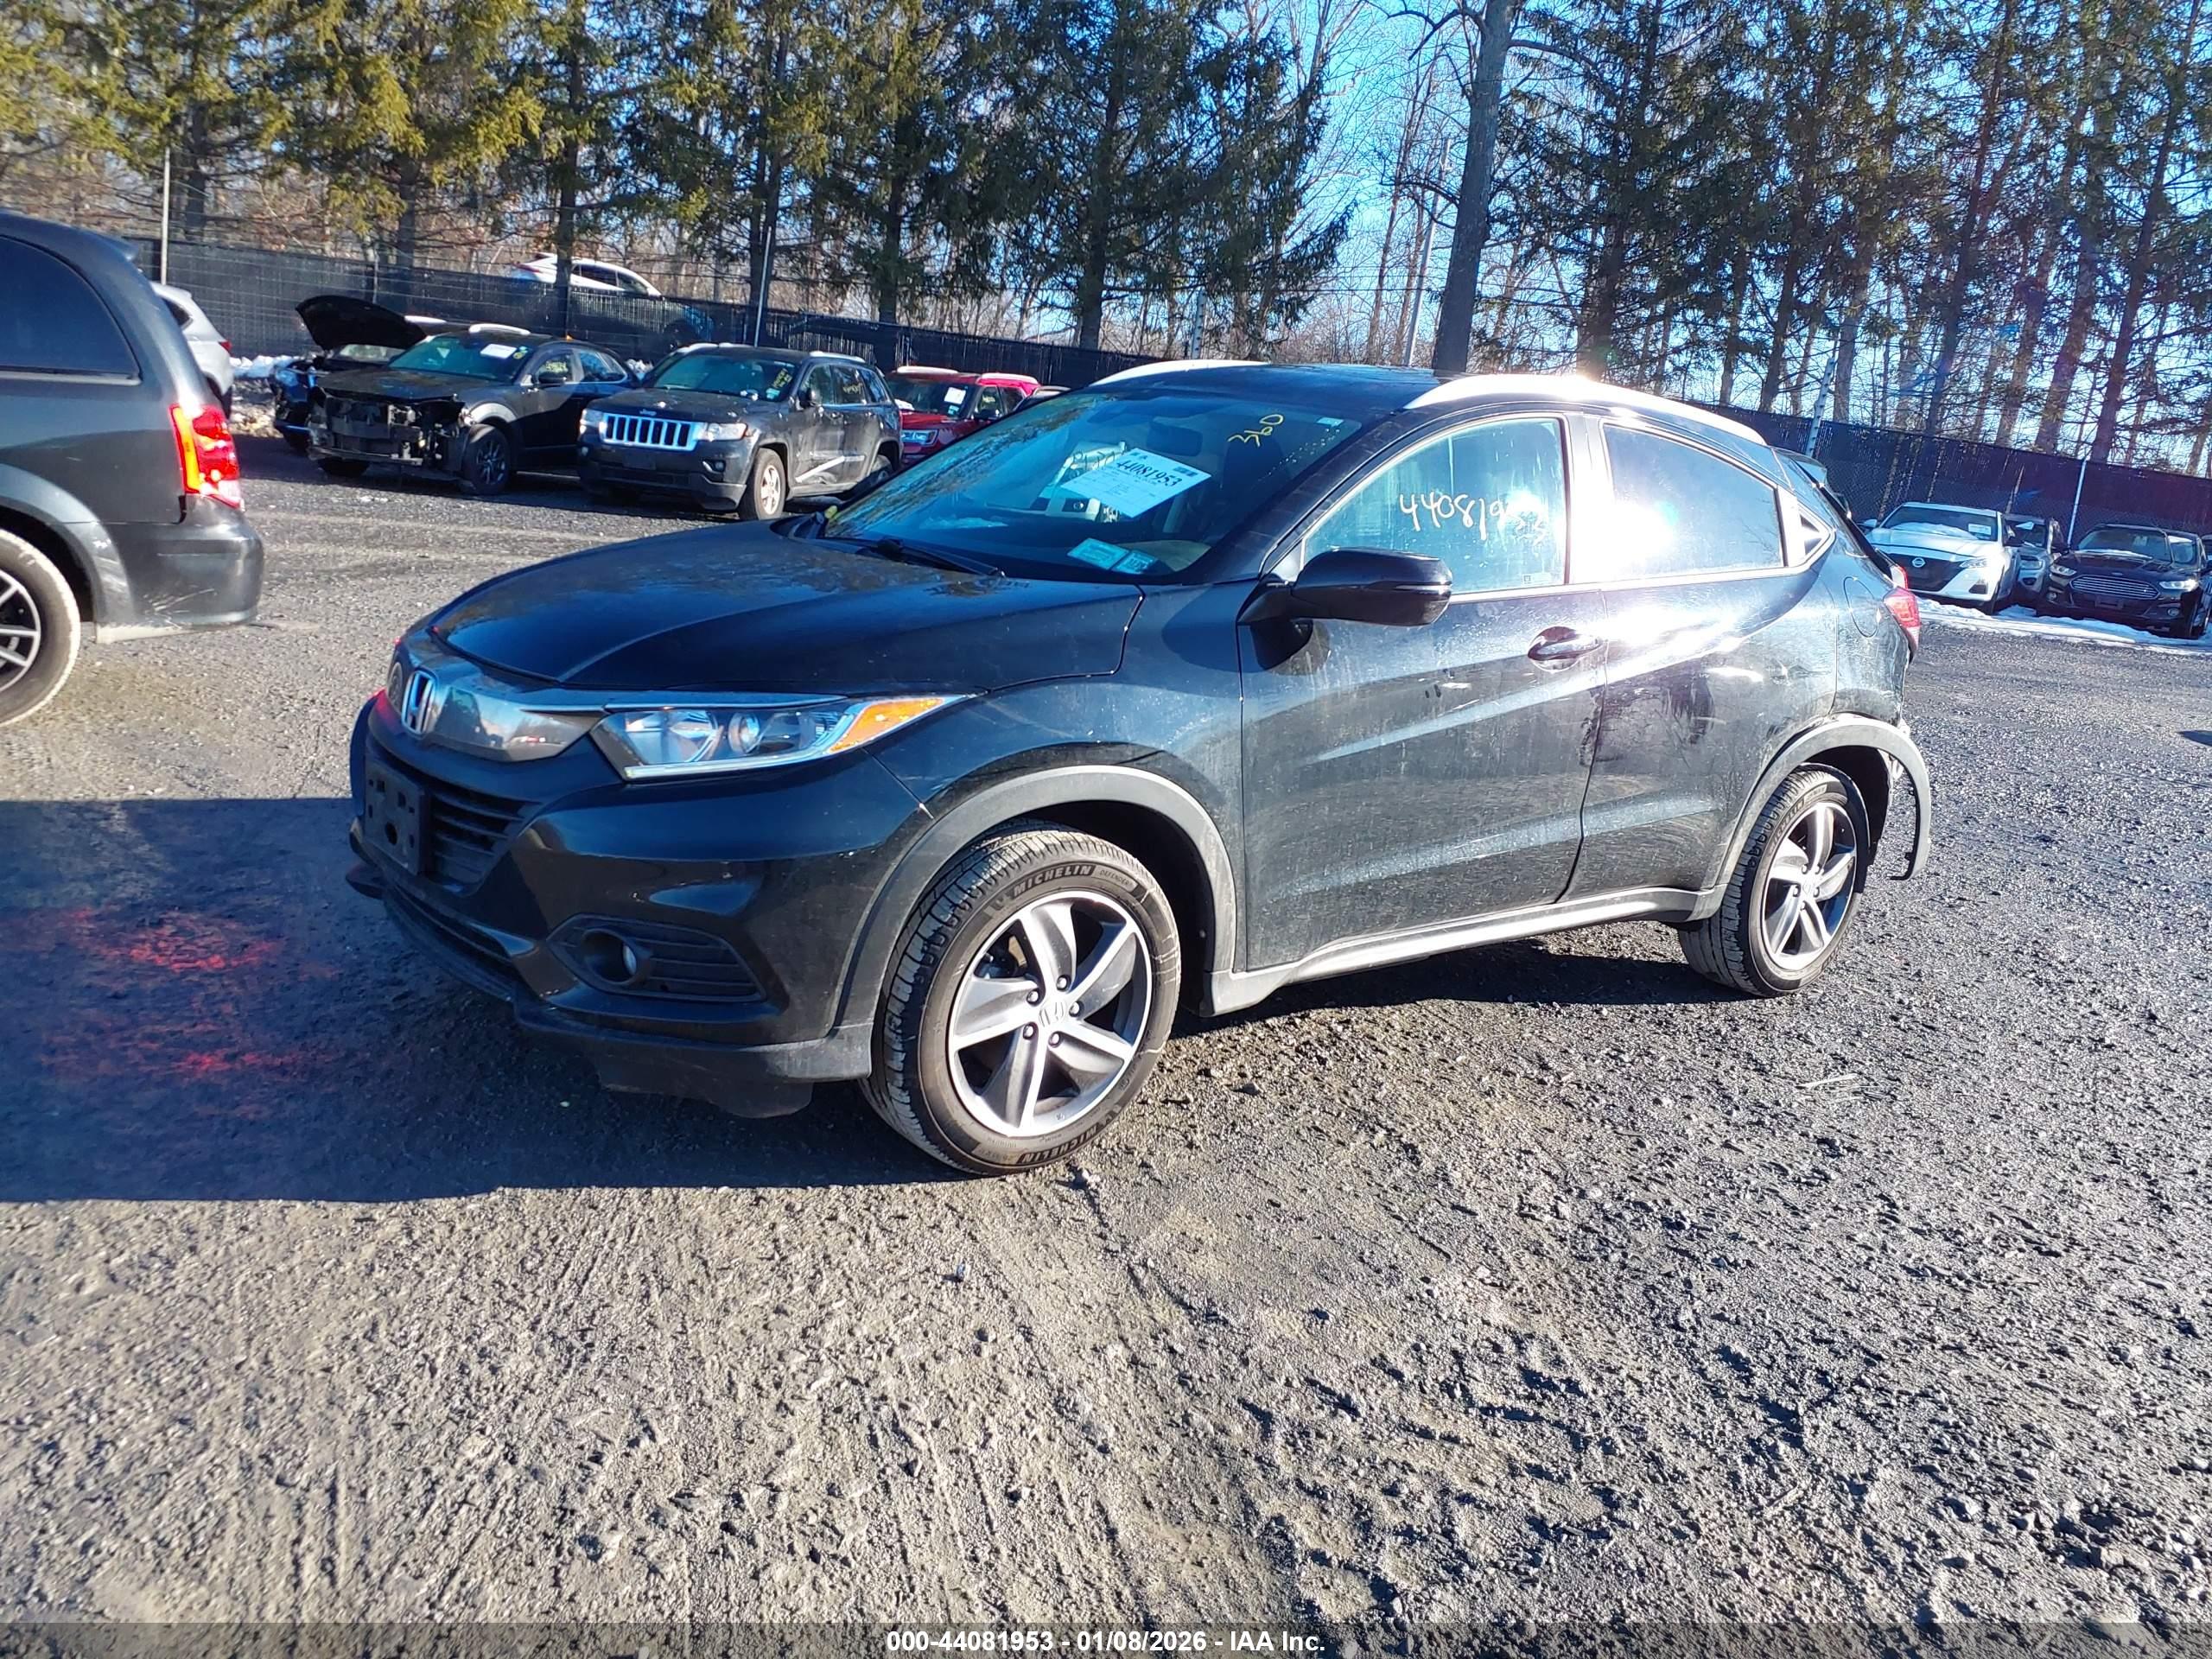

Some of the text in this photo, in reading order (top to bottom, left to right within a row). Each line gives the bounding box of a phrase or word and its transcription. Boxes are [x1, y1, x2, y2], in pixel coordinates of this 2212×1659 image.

[1227, 414, 1284, 448] 360
[1116, 459, 1183, 487] 44081953
[1014, 865, 1092, 898] MICHELIN
[1021, 1125, 1098, 1164] MICHELIN
